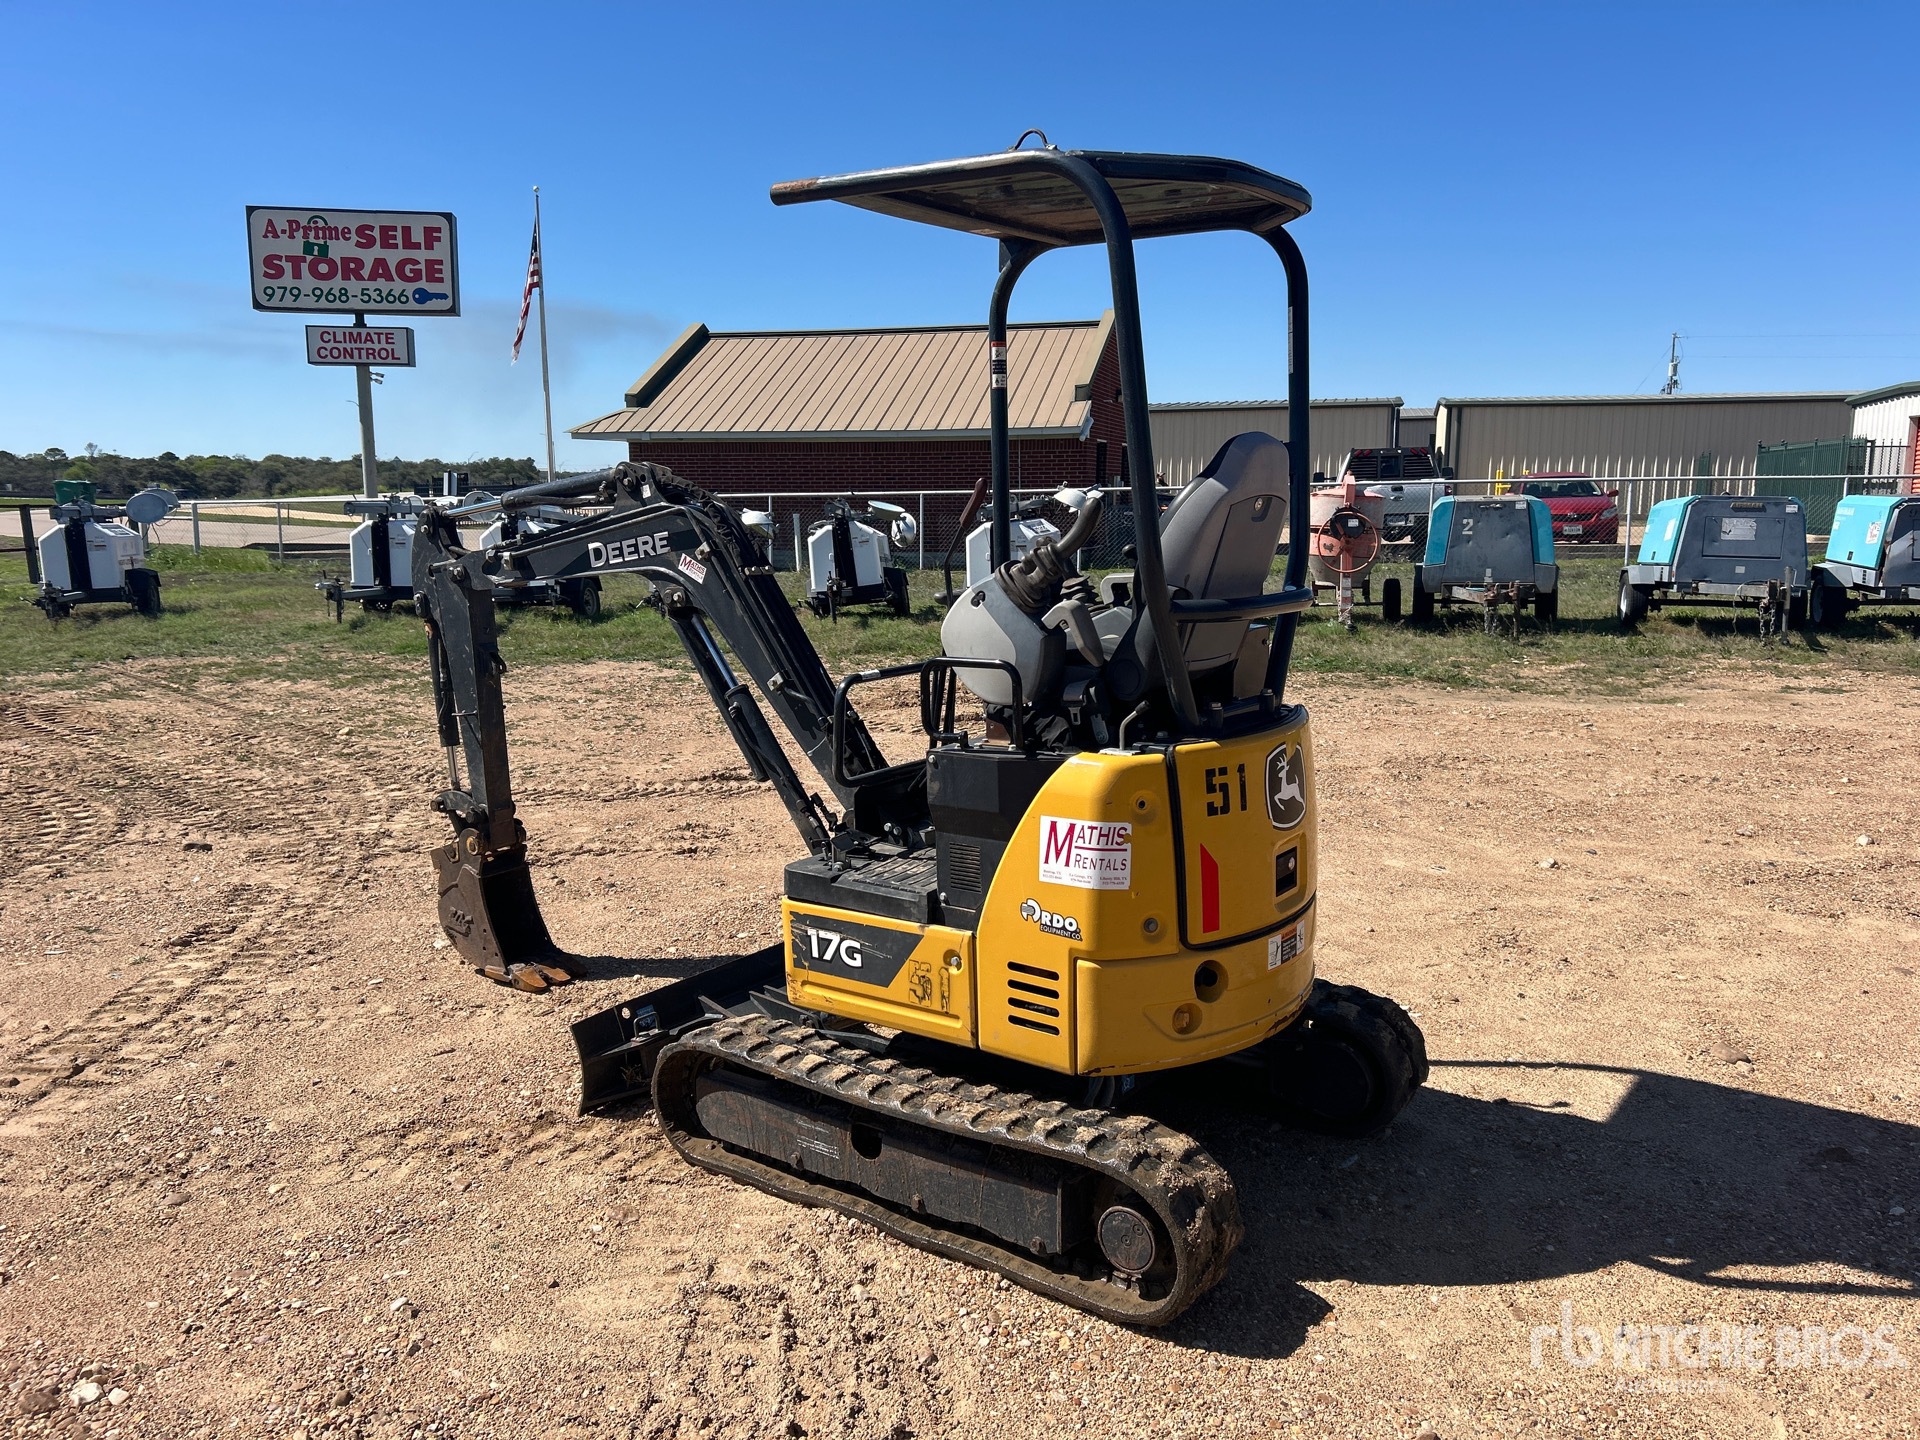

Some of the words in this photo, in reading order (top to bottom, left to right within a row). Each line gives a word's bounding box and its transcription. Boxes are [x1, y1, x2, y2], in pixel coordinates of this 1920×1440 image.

[262, 218, 351, 242] A-Prime
[354, 223, 442, 250] SELF
[262, 254, 445, 283] STORAGE
[262, 286, 410, 305] 979-968-5366
[319, 330, 396, 345] CLIMATE
[316, 346, 401, 361] CONTROL
[1461, 518, 1474, 535] 2
[587, 531, 671, 568] DEERE
[1205, 763, 1247, 817] 51
[1043, 820, 1129, 868] MATHIS
[1073, 853, 1128, 871] RENTALS
[1040, 924, 1071, 938] EQUIPMENT
[807, 927, 863, 968] 17G
